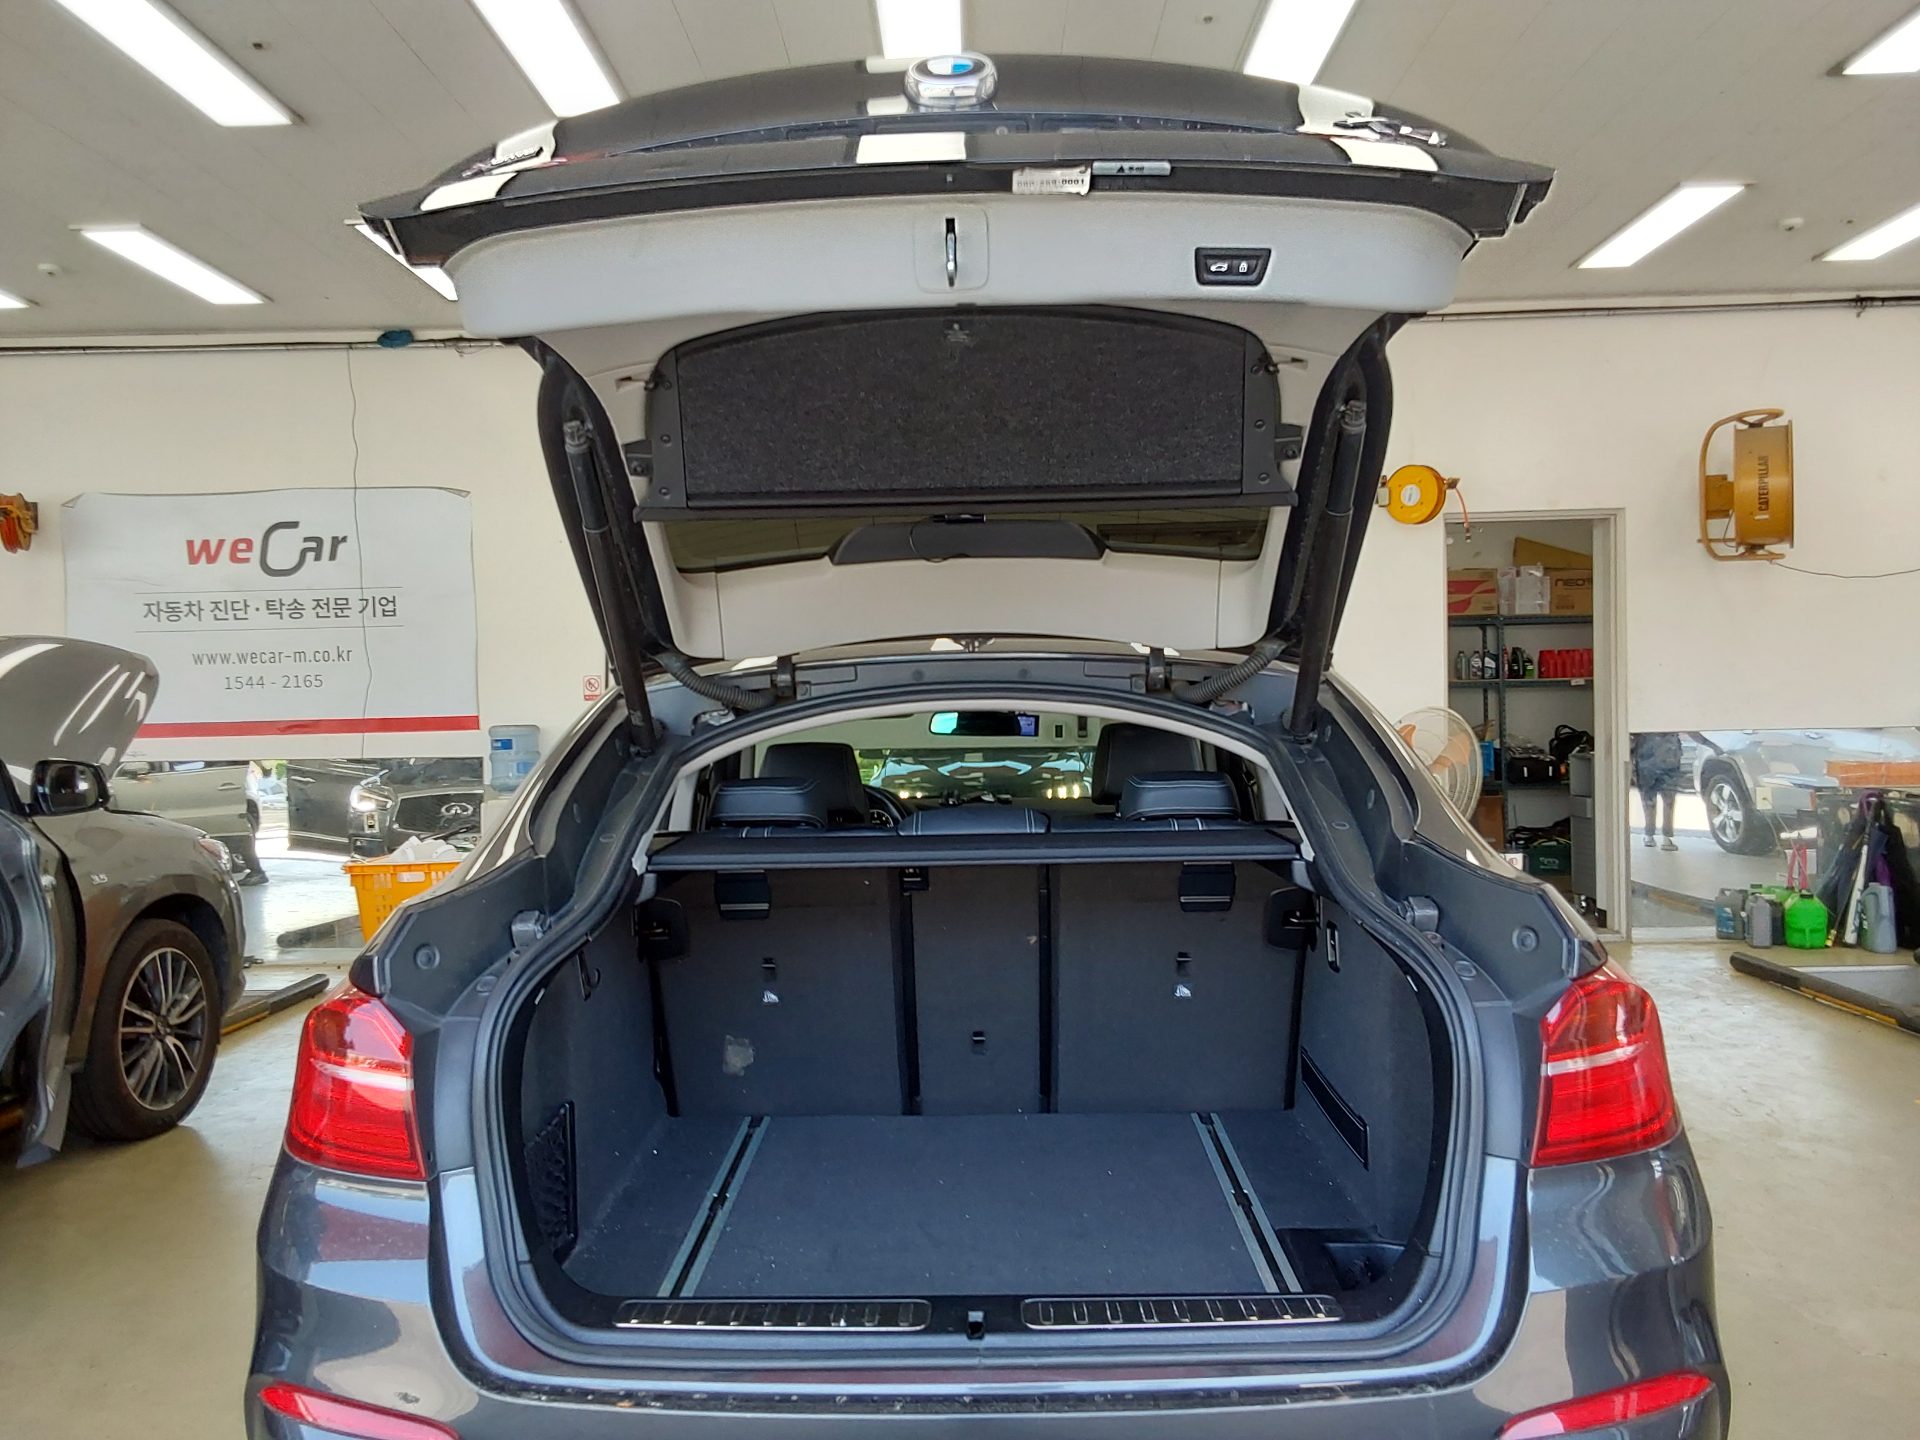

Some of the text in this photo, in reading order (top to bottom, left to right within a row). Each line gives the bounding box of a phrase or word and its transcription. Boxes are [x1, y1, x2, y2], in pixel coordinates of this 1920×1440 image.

[1758, 456, 1770, 512] CATERPILLAR
[142, 600, 205, 622] 자동차
[312, 596, 352, 619] 전문
[357, 595, 397, 619] 기업
[192, 646, 353, 665] www.wecar-m.co.kr
